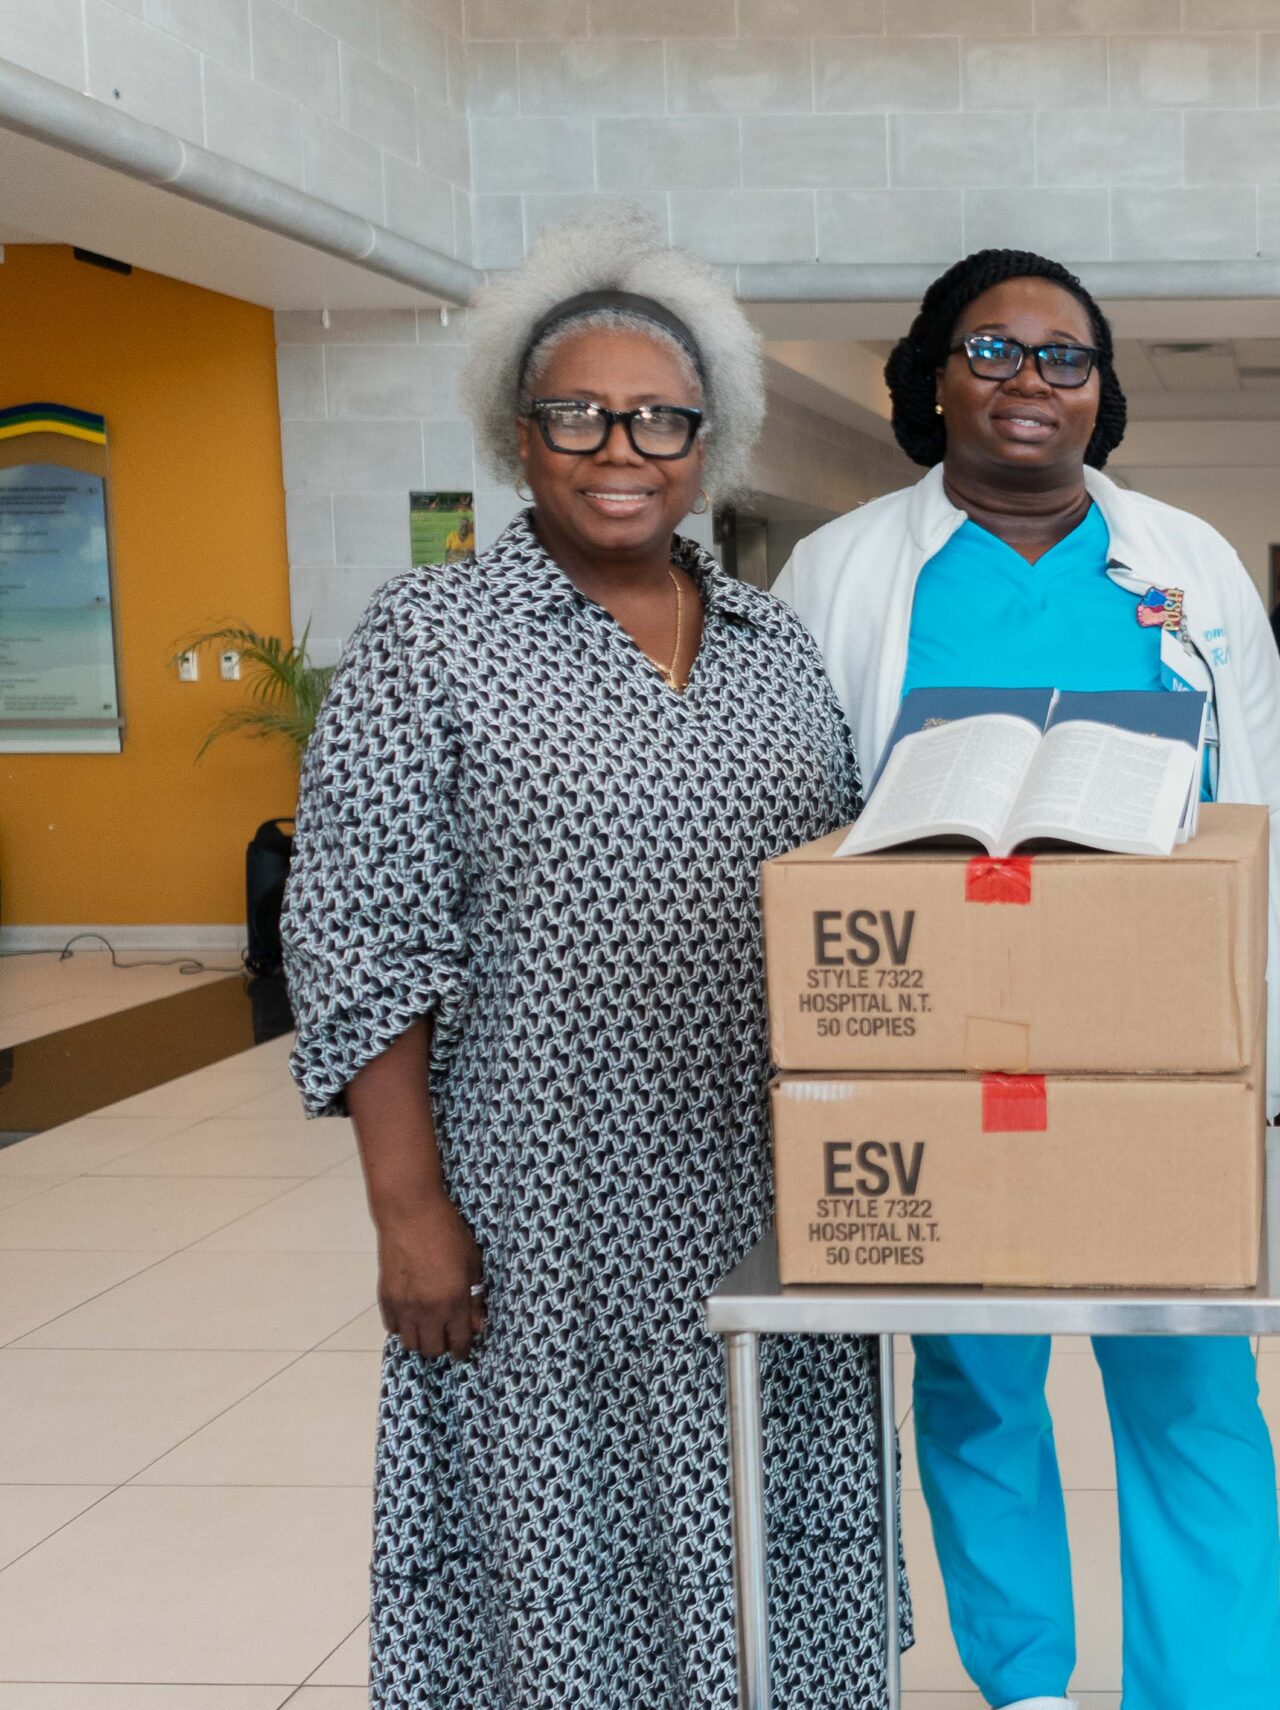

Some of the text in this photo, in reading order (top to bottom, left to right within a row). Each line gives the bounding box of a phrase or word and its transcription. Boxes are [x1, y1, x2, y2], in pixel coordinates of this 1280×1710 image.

[812, 910, 916, 967] ESV
[806, 968, 923, 989] STYLE 7322
[799, 993, 933, 1013] HOSPITAL N.T.
[816, 1017, 916, 1037] 50 COPIES
[822, 1141, 925, 1197] ESV
[816, 1199, 933, 1219] STYLE 7322
[808, 1222, 941, 1243] HOSPITAL N.T.
[825, 1246, 924, 1266] 50 COPIES
